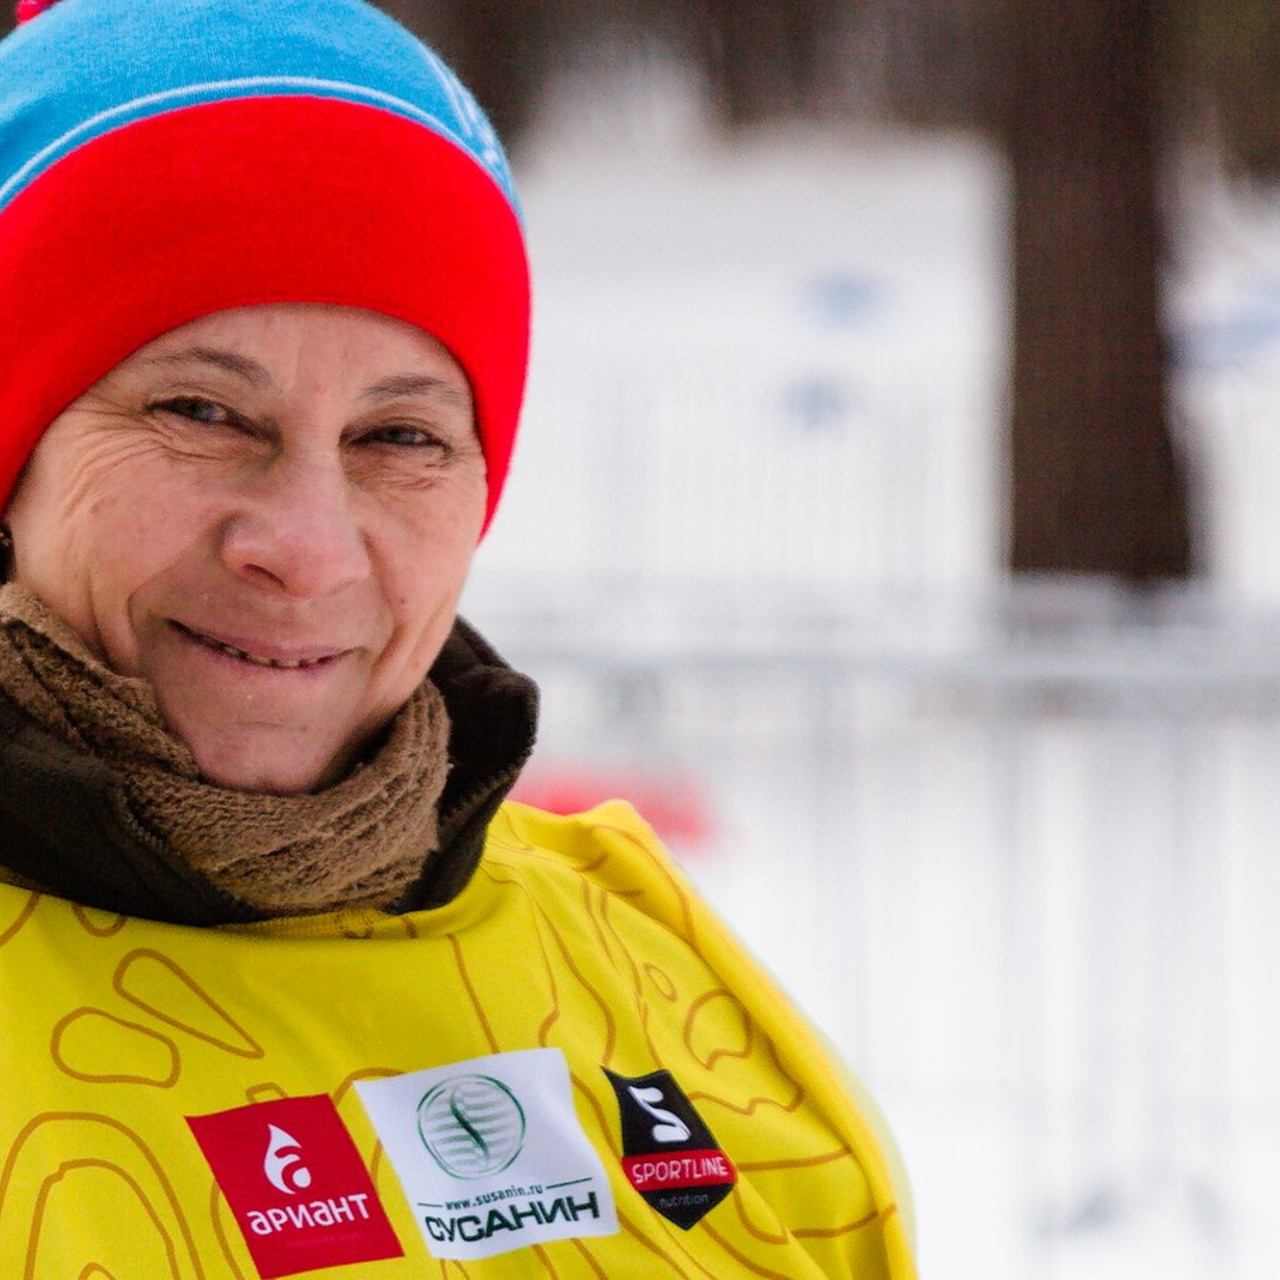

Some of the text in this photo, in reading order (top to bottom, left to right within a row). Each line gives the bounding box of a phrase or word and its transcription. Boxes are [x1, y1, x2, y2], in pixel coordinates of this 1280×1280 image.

[631, 1156, 729, 1184] SPORTLINE
[444, 1184, 544, 1211] www.susanin.ru
[424, 1190, 601, 1243] СУСАНИН
